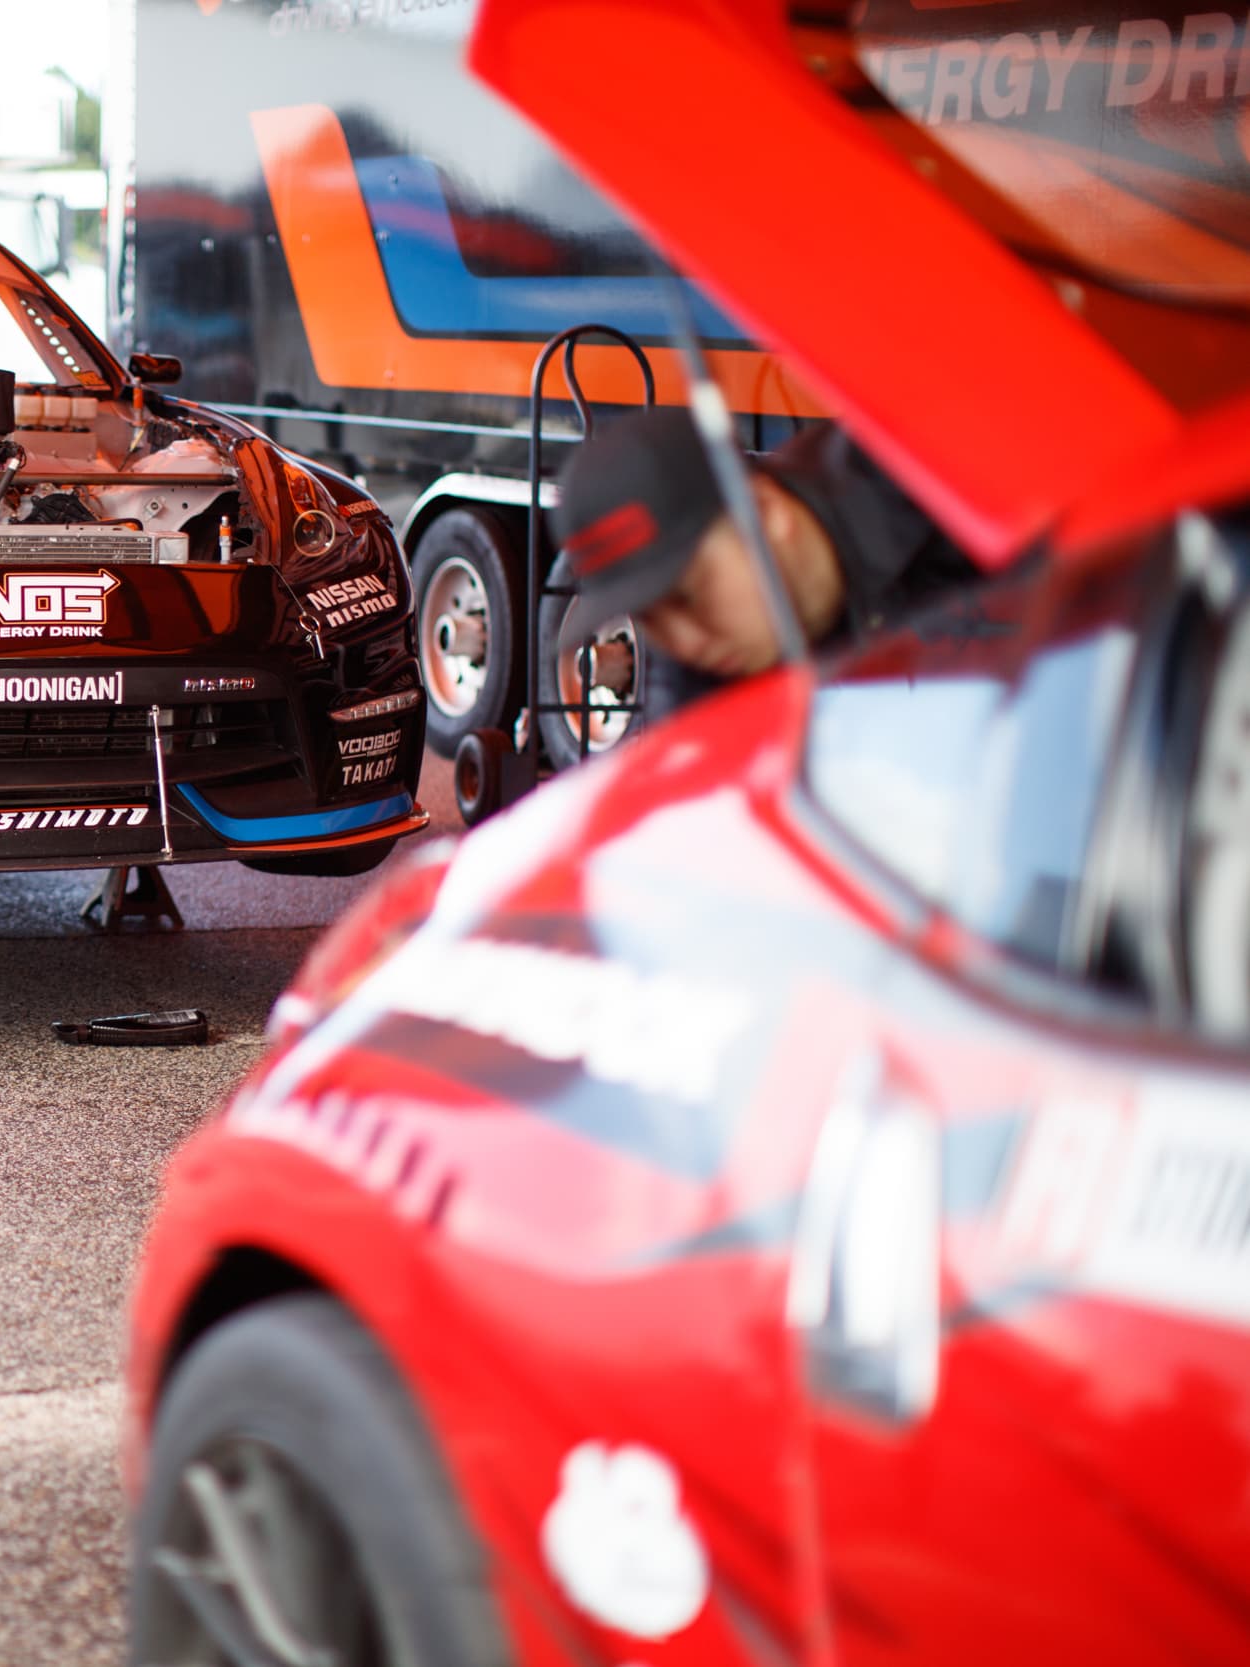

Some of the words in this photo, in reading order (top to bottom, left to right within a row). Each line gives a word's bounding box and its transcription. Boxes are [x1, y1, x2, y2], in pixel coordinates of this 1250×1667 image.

[306, 574, 386, 611] NISSAN
[326, 593, 398, 628] nismo
[49, 626, 103, 638] DRINK
